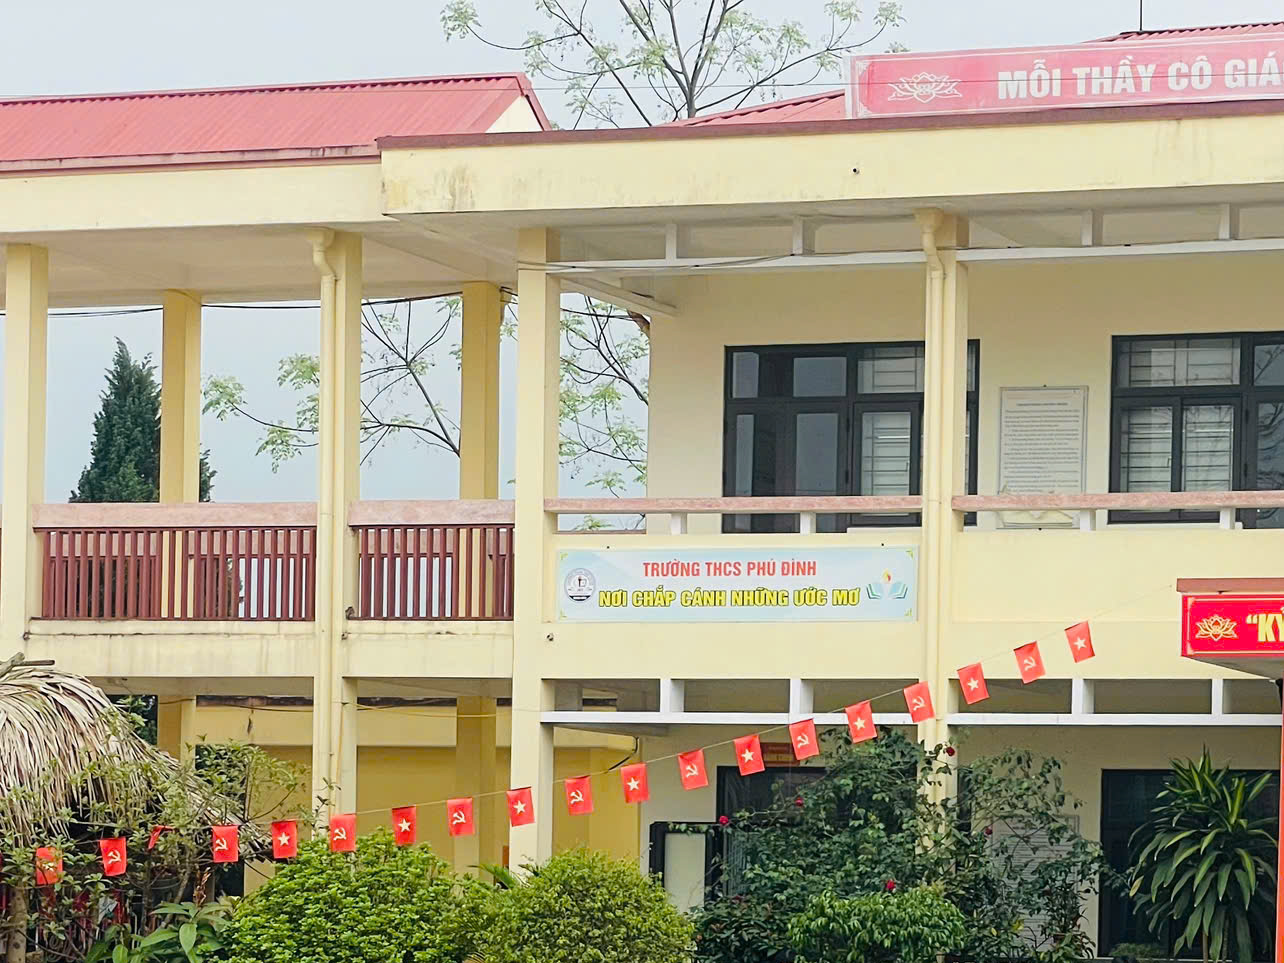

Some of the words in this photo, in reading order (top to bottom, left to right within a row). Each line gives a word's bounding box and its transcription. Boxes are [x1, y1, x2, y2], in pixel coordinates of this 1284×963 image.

[998, 58, 1060, 99] MỖI
[1072, 55, 1157, 96] THẦY
[1168, 55, 1212, 91] CÔ
[643, 558, 700, 577] TRƯỜNG
[705, 561, 742, 577] THCS
[747, 558, 776, 577] PHÚ
[781, 558, 817, 576] ĐÌNH
[598, 589, 628, 608] NƠI
[632, 585, 676, 608] CHẮP
[680, 587, 726, 608] CÁNH
[731, 585, 789, 607] NHỮNG
[793, 586, 829, 607] ƯỚC
[832, 587, 861, 606] MƠ
